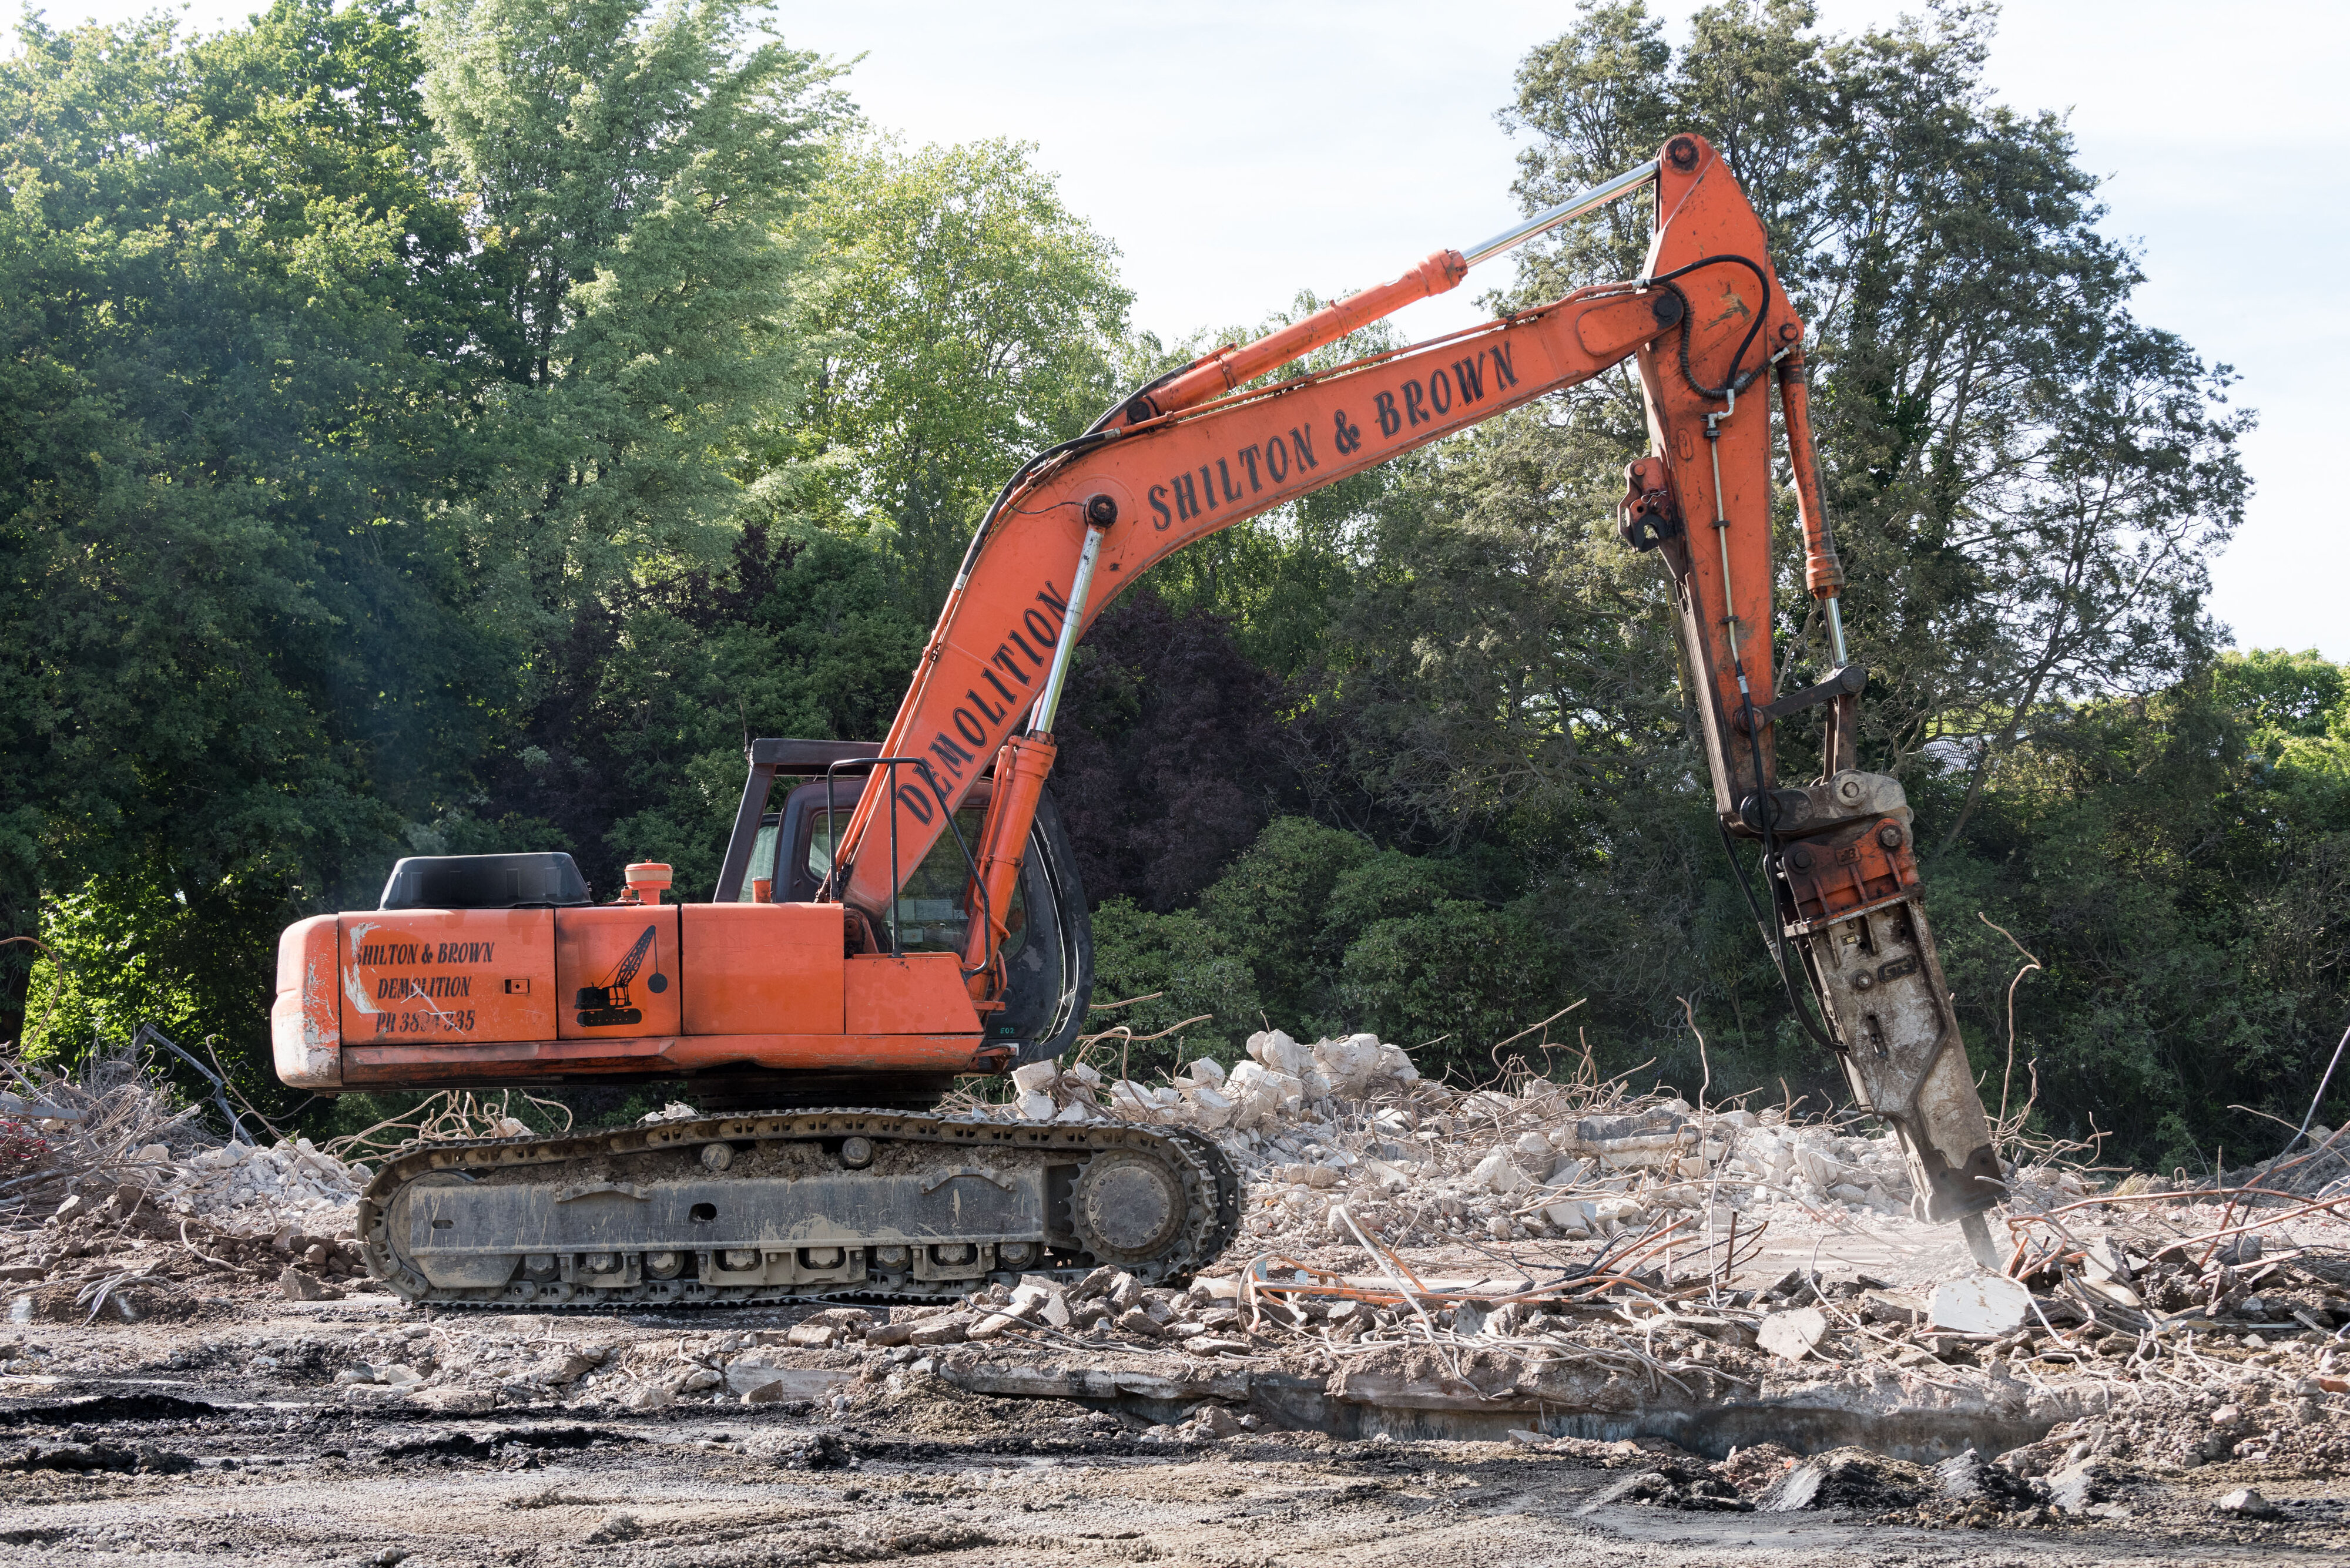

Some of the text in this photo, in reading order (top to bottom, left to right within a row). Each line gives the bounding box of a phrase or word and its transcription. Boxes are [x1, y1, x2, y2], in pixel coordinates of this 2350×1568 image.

[1148, 340, 1519, 532] SHILTON & BROWN
[896, 580, 1068, 826] DEMOLITION
[421, 943, 433, 964] &
[437, 942, 495, 964] BROWN
[378, 976, 471, 999] DEMOLITION
[376, 1012, 396, 1033] PH
